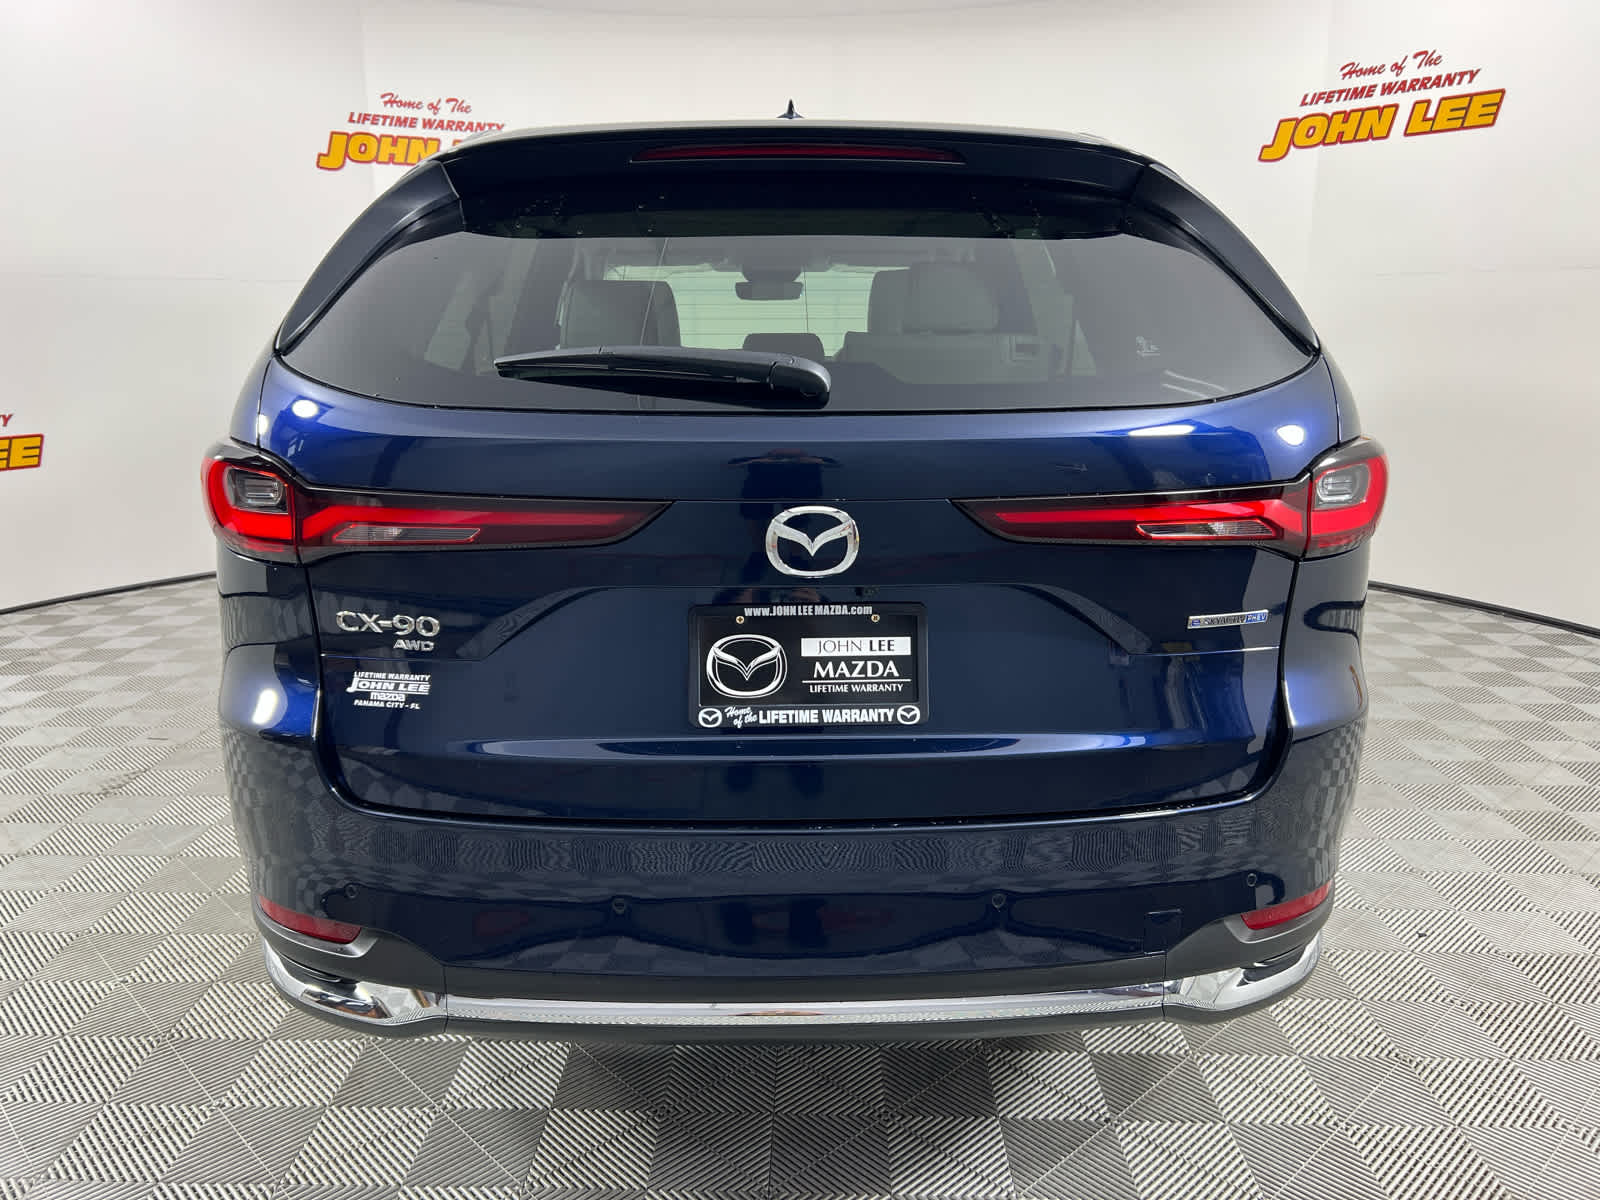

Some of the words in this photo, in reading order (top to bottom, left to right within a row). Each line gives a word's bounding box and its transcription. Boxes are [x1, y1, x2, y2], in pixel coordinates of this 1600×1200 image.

[1340, 62, 1386, 80] Home
[1390, 56, 1408, 77] of
[1413, 49, 1443, 70] The
[1300, 84, 1378, 107] LIFETIME
[1380, 68, 1481, 97] WARRANTY
[380, 92, 424, 110] Home
[427, 98, 441, 115] of
[445, 98, 473, 114] The
[347, 111, 418, 129] LIFETIME
[1258, 103, 1400, 162] JOHN
[1403, 88, 1506, 137] LEE
[316, 131, 441, 171] JOHN
[336, 610, 440, 637] CX-90
[393, 639, 435, 652] AWD
[817, 639, 863, 655] JOHN
[868, 638, 896, 652] LEE
[354, 671, 386, 679] LIFETIME
[388, 673, 431, 681] WARRANTY
[813, 659, 900, 679] MAZDA
[346, 677, 395, 693] JOHN
[397, 681, 431, 693] LEE
[809, 683, 849, 694] LIFETIME
[851, 683, 904, 694] WARRANTY
[353, 699, 385, 708] PANAMA
[724, 705, 753, 719] Home
[733, 714, 744, 729] of
[758, 709, 818, 724] LIFETIME
[821, 708, 895, 723] WARRANTY
